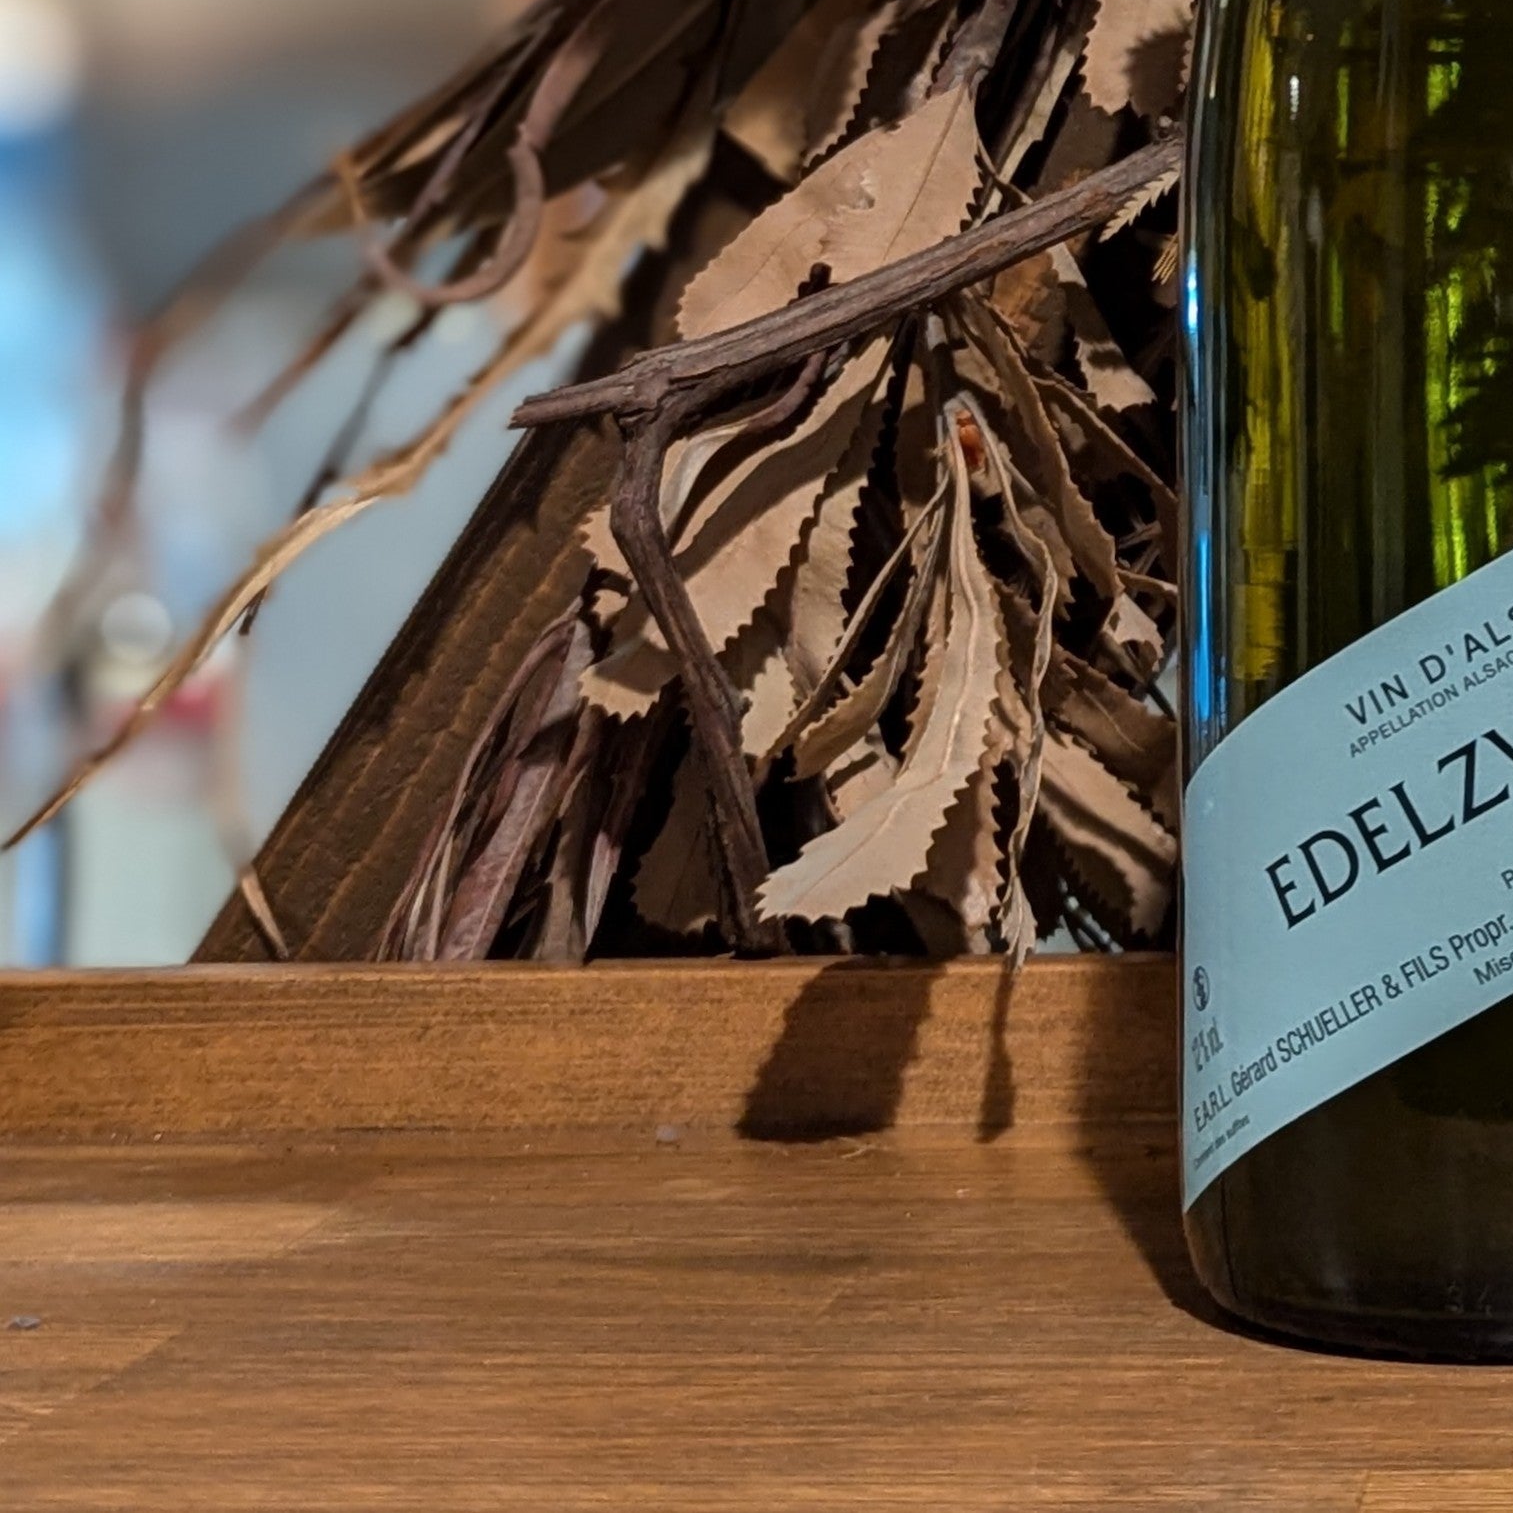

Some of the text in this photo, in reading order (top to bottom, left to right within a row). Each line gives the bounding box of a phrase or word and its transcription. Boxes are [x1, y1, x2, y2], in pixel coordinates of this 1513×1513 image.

[1344, 674, 1410, 726] VIN
[1350, 683, 1459, 758] APPELLATION
[1230, 1046, 1277, 1097] Gérard
[1276, 984, 1383, 1063] SCHUELLER
[1382, 973, 1403, 1001] &
[1400, 945, 1450, 989] FILS
